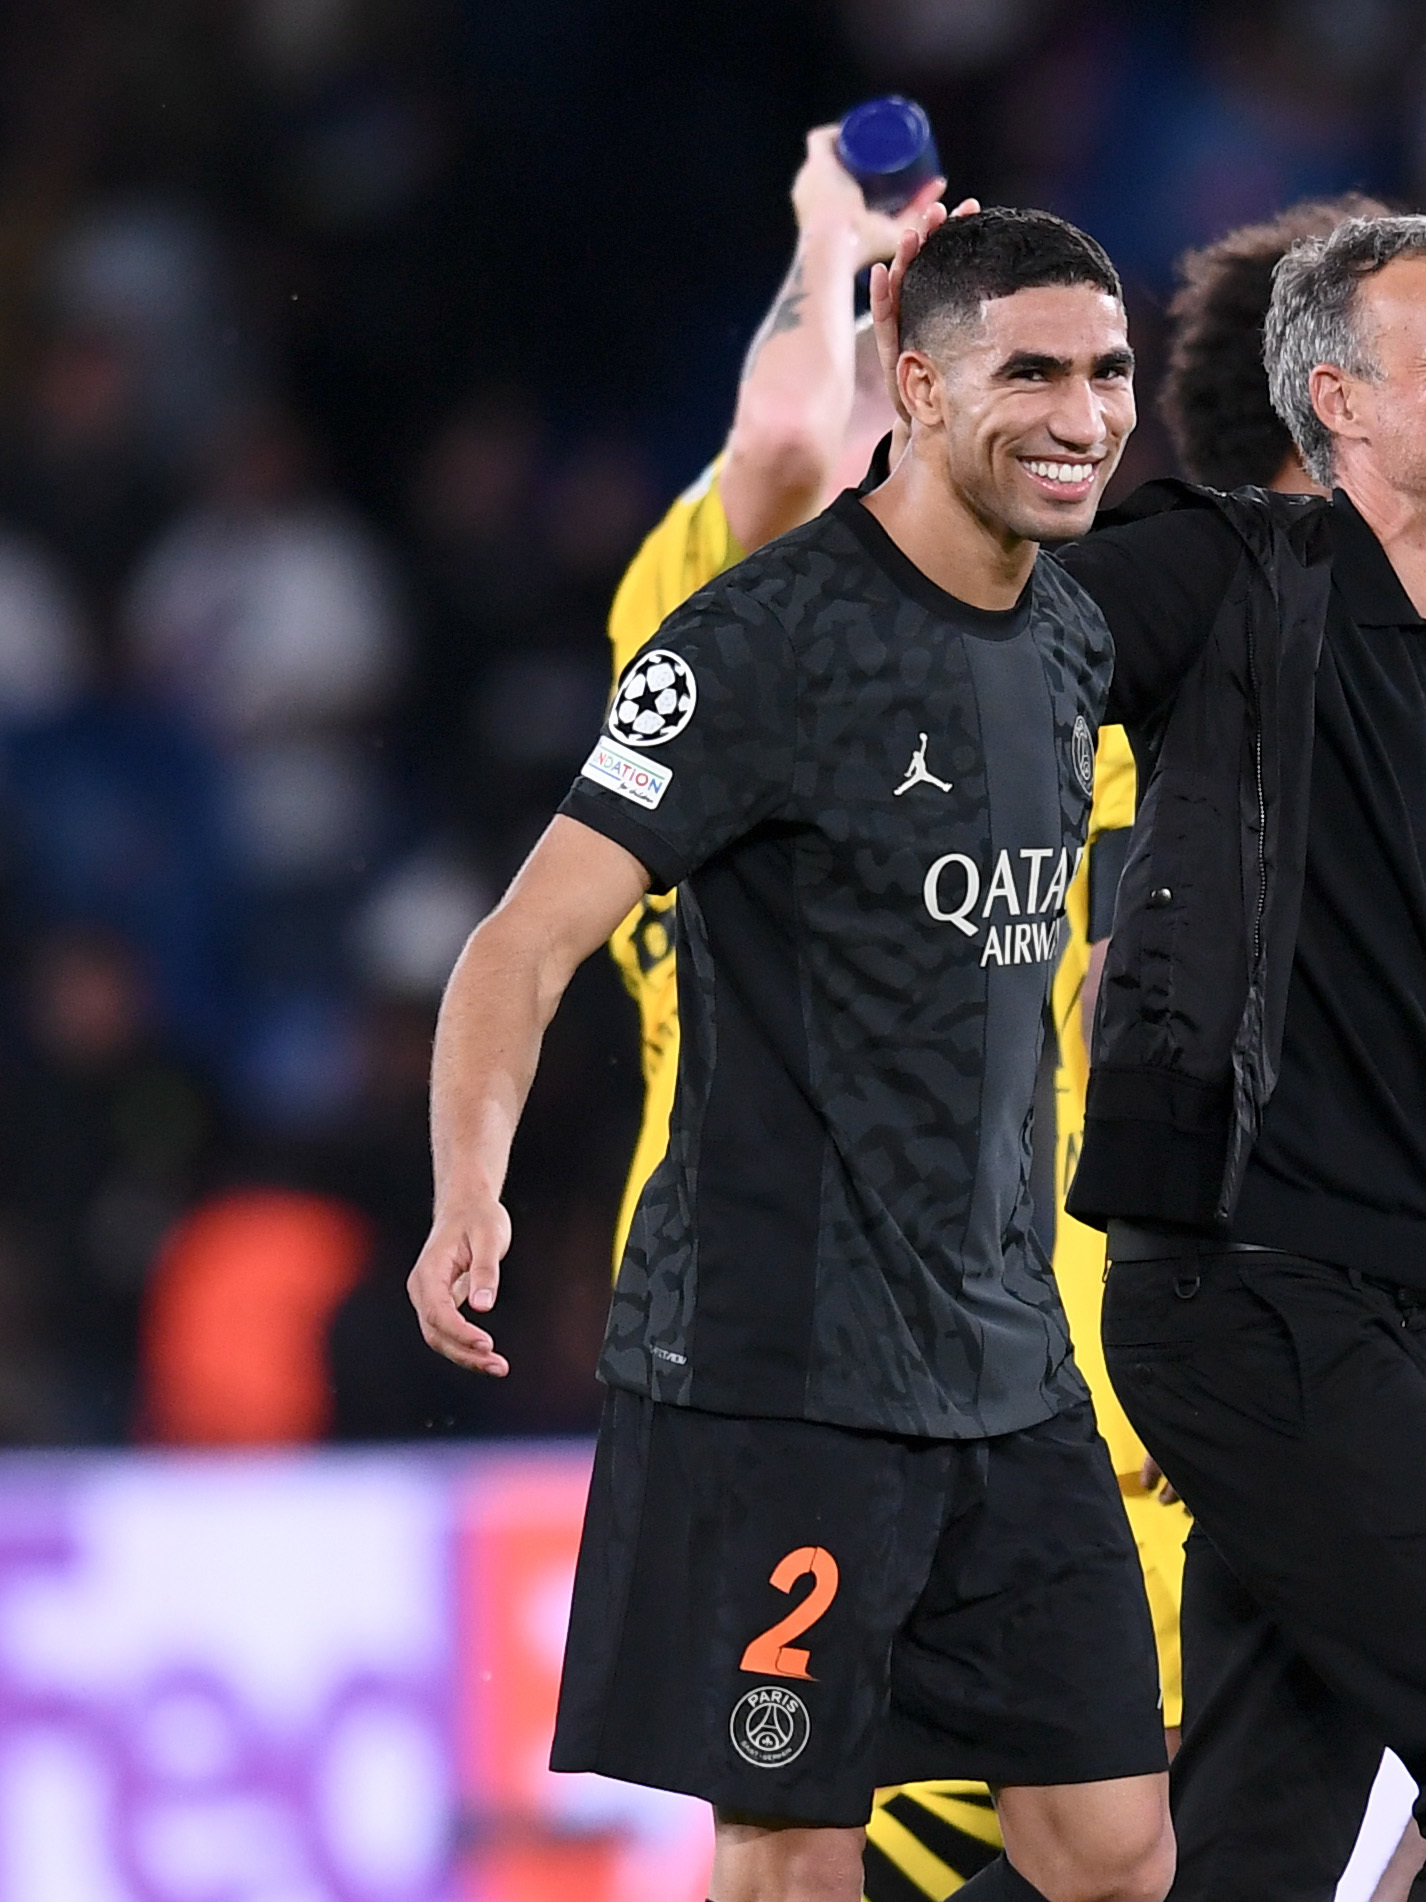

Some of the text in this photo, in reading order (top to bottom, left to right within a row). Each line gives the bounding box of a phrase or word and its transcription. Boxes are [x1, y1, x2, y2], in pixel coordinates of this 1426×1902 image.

[593, 752, 662, 794] NDATION
[740, 1546, 839, 1681] 2
[747, 1689, 799, 1713] PARIS
